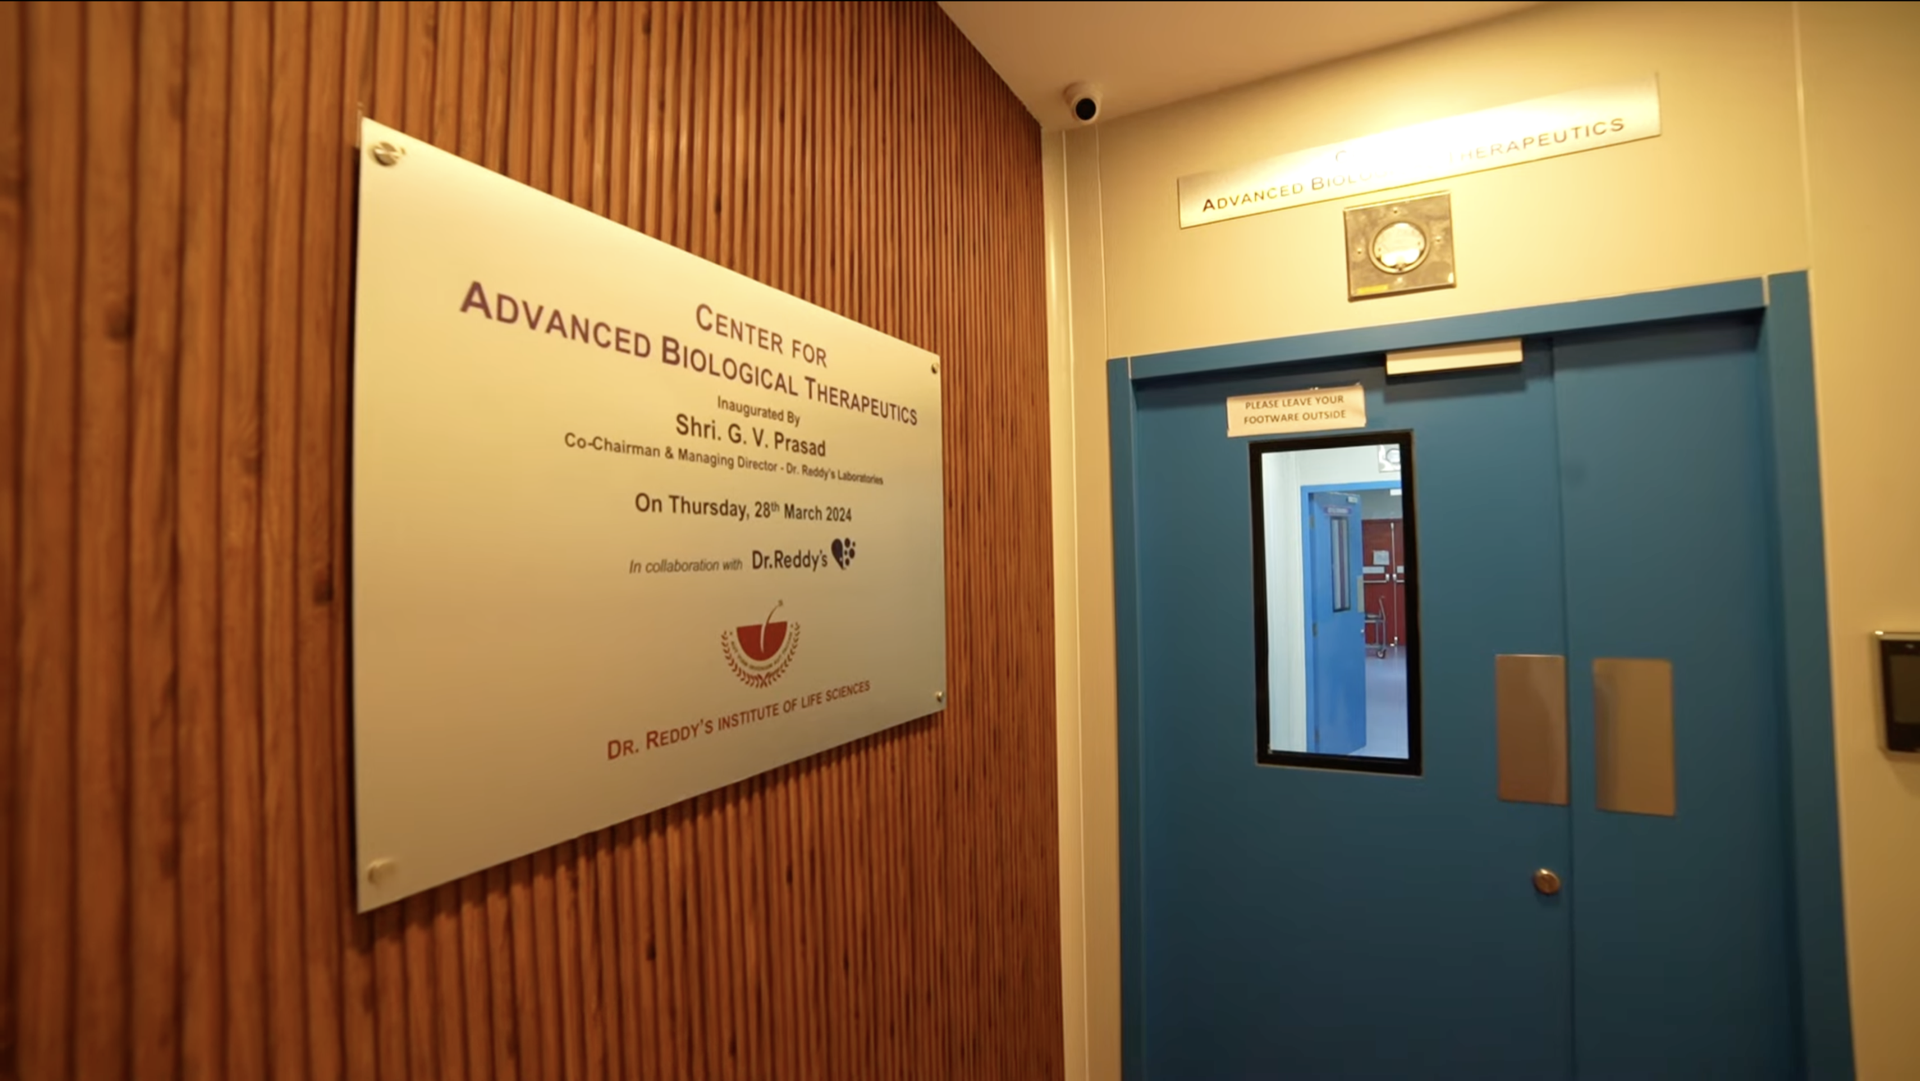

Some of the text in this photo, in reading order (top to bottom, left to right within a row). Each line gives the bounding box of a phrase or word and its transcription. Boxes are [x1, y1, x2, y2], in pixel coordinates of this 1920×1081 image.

[1202, 181, 1304, 213] ADVANCED
[696, 303, 828, 368] CENTER FOR
[459, 281, 919, 427] ADVANCED BIOLOGICAL THERAPEUTICS
[717, 395, 801, 427] Inaugurated By
[1244, 409, 1347, 425] FOOTWARE OUTSIDE
[1245, 394, 1345, 411] PLEASE LEAVE YOUR
[675, 413, 827, 458] Shri. G. V. Prasad
[564, 432, 661, 459] Co-Chairman
[664, 446, 675, 460] &
[678, 448, 735, 471] Managing
[737, 455, 778, 473] Director
[786, 462, 800, 476] Dr.
[801, 464, 836, 482] Reddy's
[837, 469, 884, 486] Laboratories
[634, 492, 853, 522] On Thursday, 28th March 2024
[629, 557, 744, 574] In collaboration with
[752, 549, 829, 573] Dr.Reddy's
[606, 680, 872, 761] DR. REDDY'S INSTITUTE OF LIFE SCIENCES
